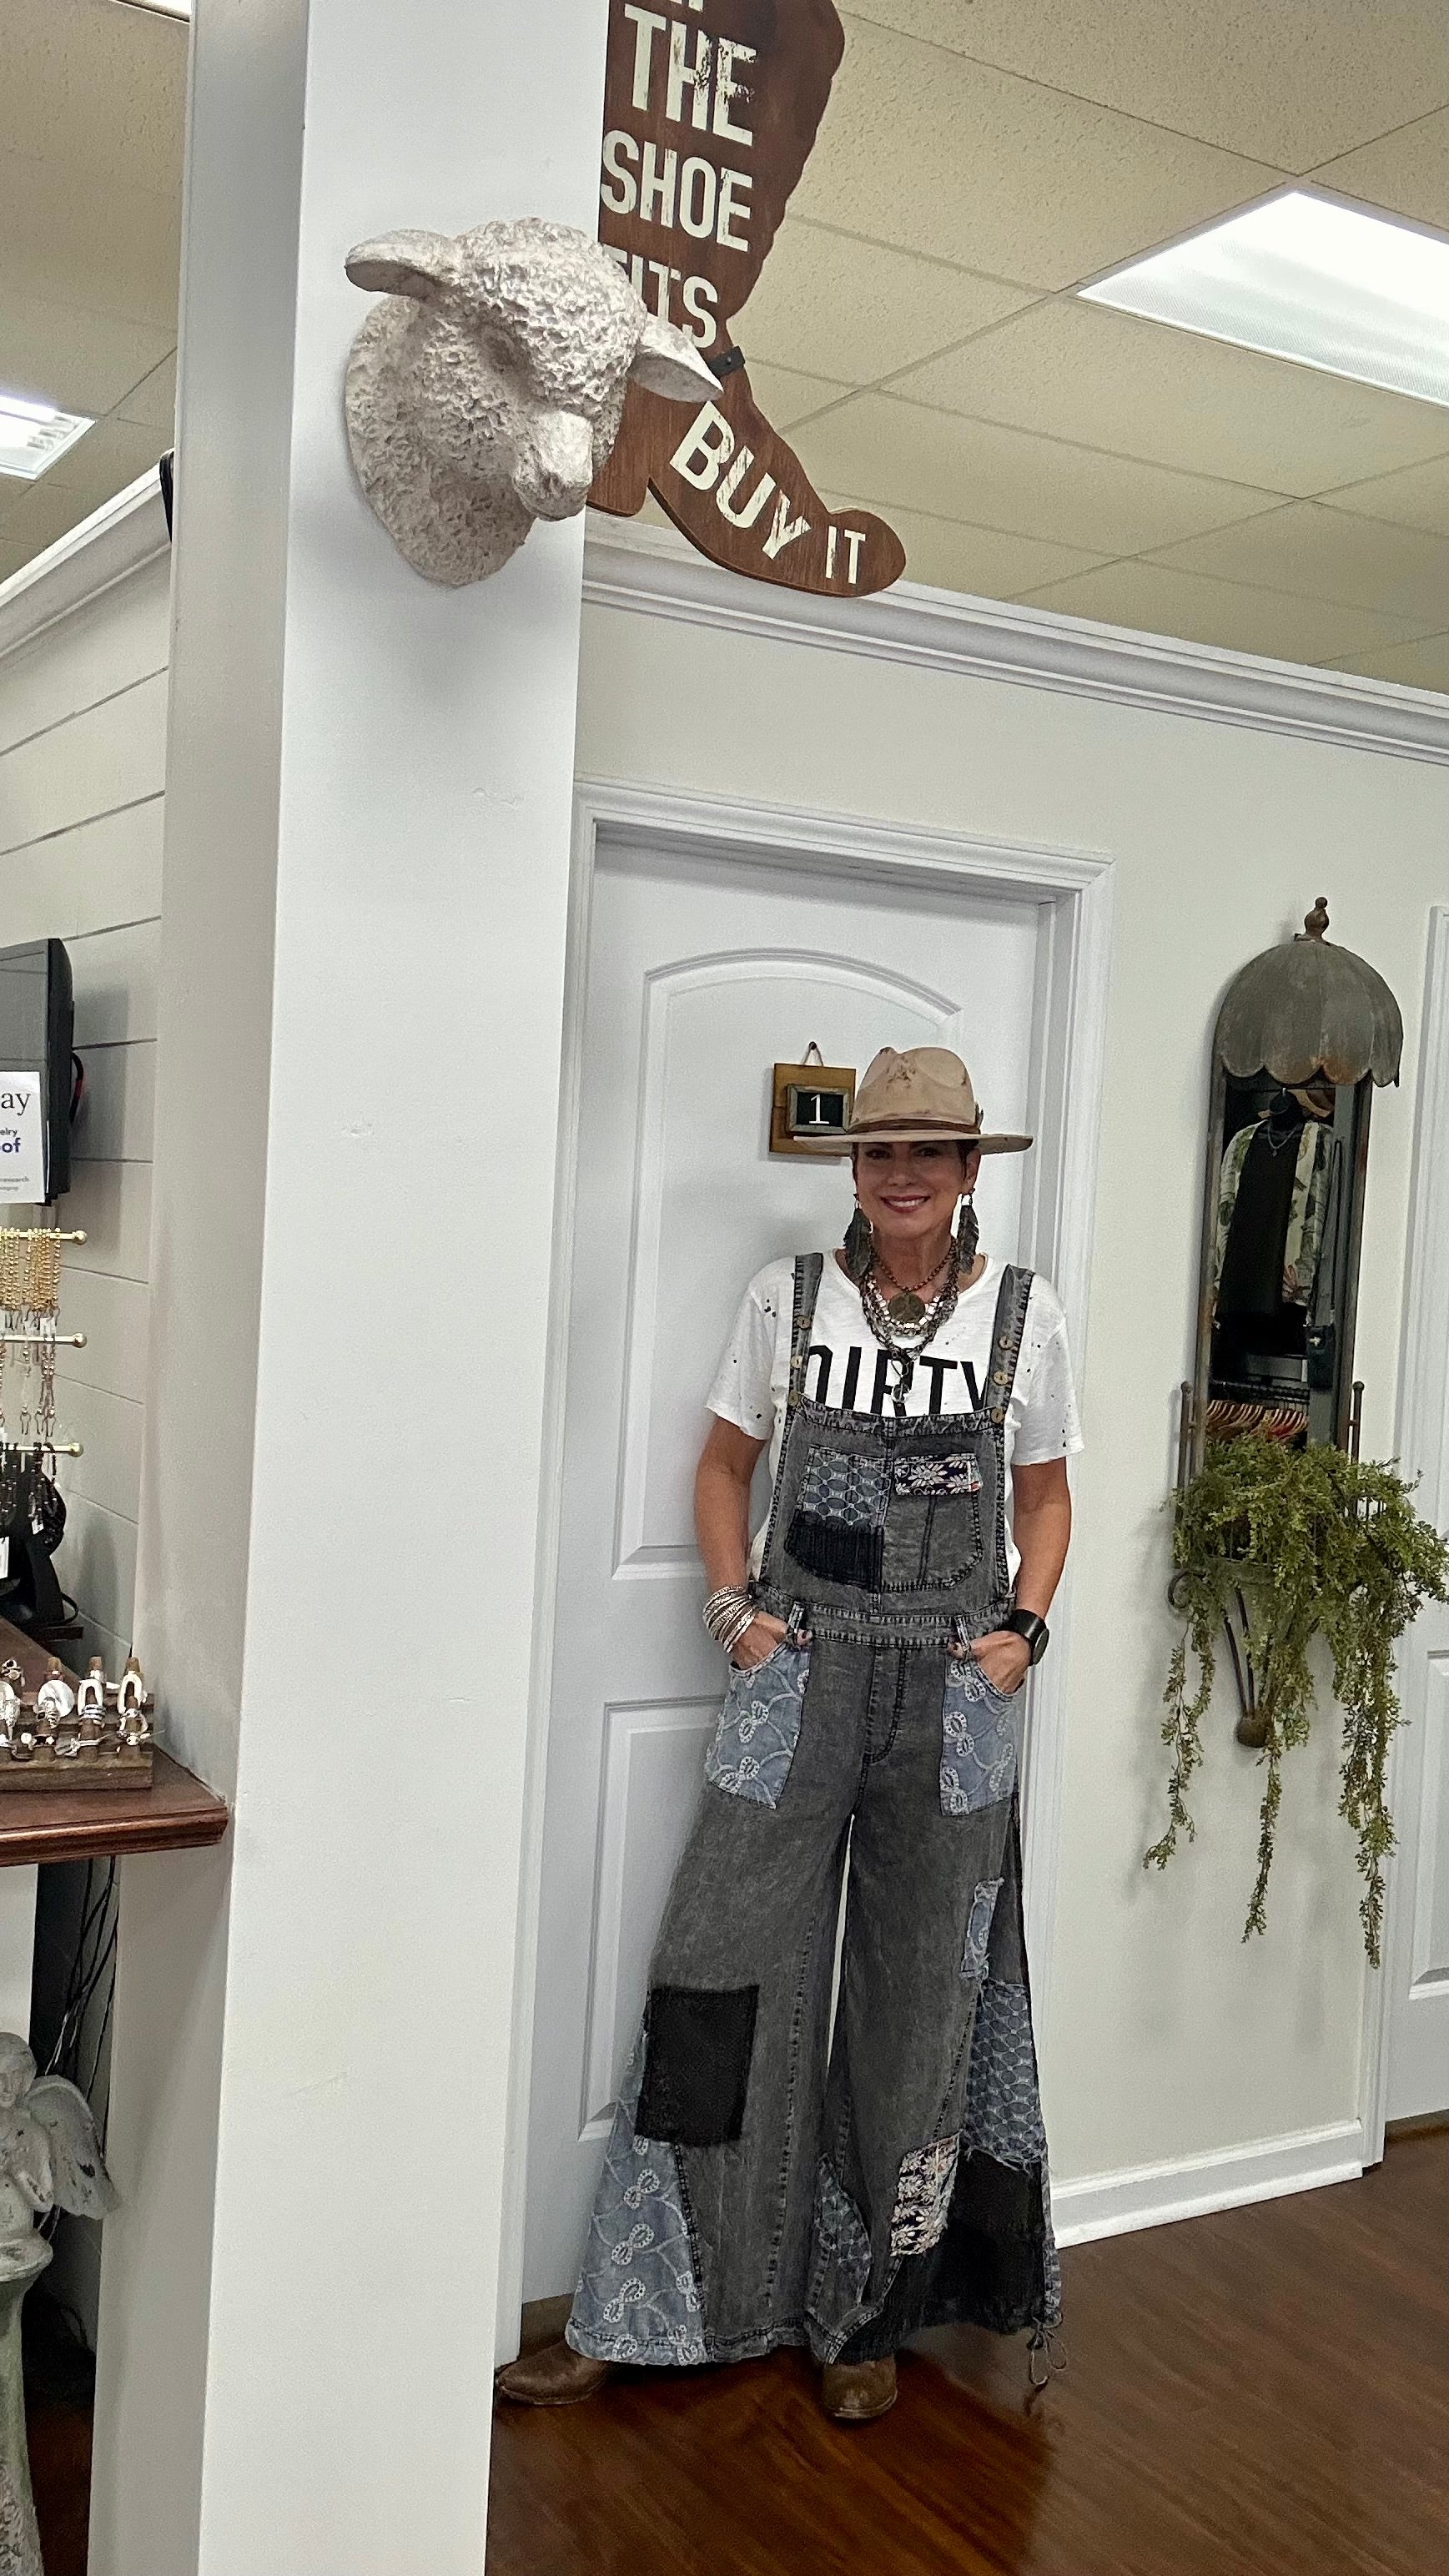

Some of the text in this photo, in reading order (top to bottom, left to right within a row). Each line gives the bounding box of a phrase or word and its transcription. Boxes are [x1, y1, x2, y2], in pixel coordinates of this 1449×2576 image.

[625, 3, 757, 147] THE
[600, 130, 752, 252] SHOE
[602, 244, 718, 348] ITS
[670, 401, 866, 584] BUY IT
[0, 1128, 18, 1137] elry
[0, 1137, 21, 1153] of
[808, 1094, 830, 1124] 1
